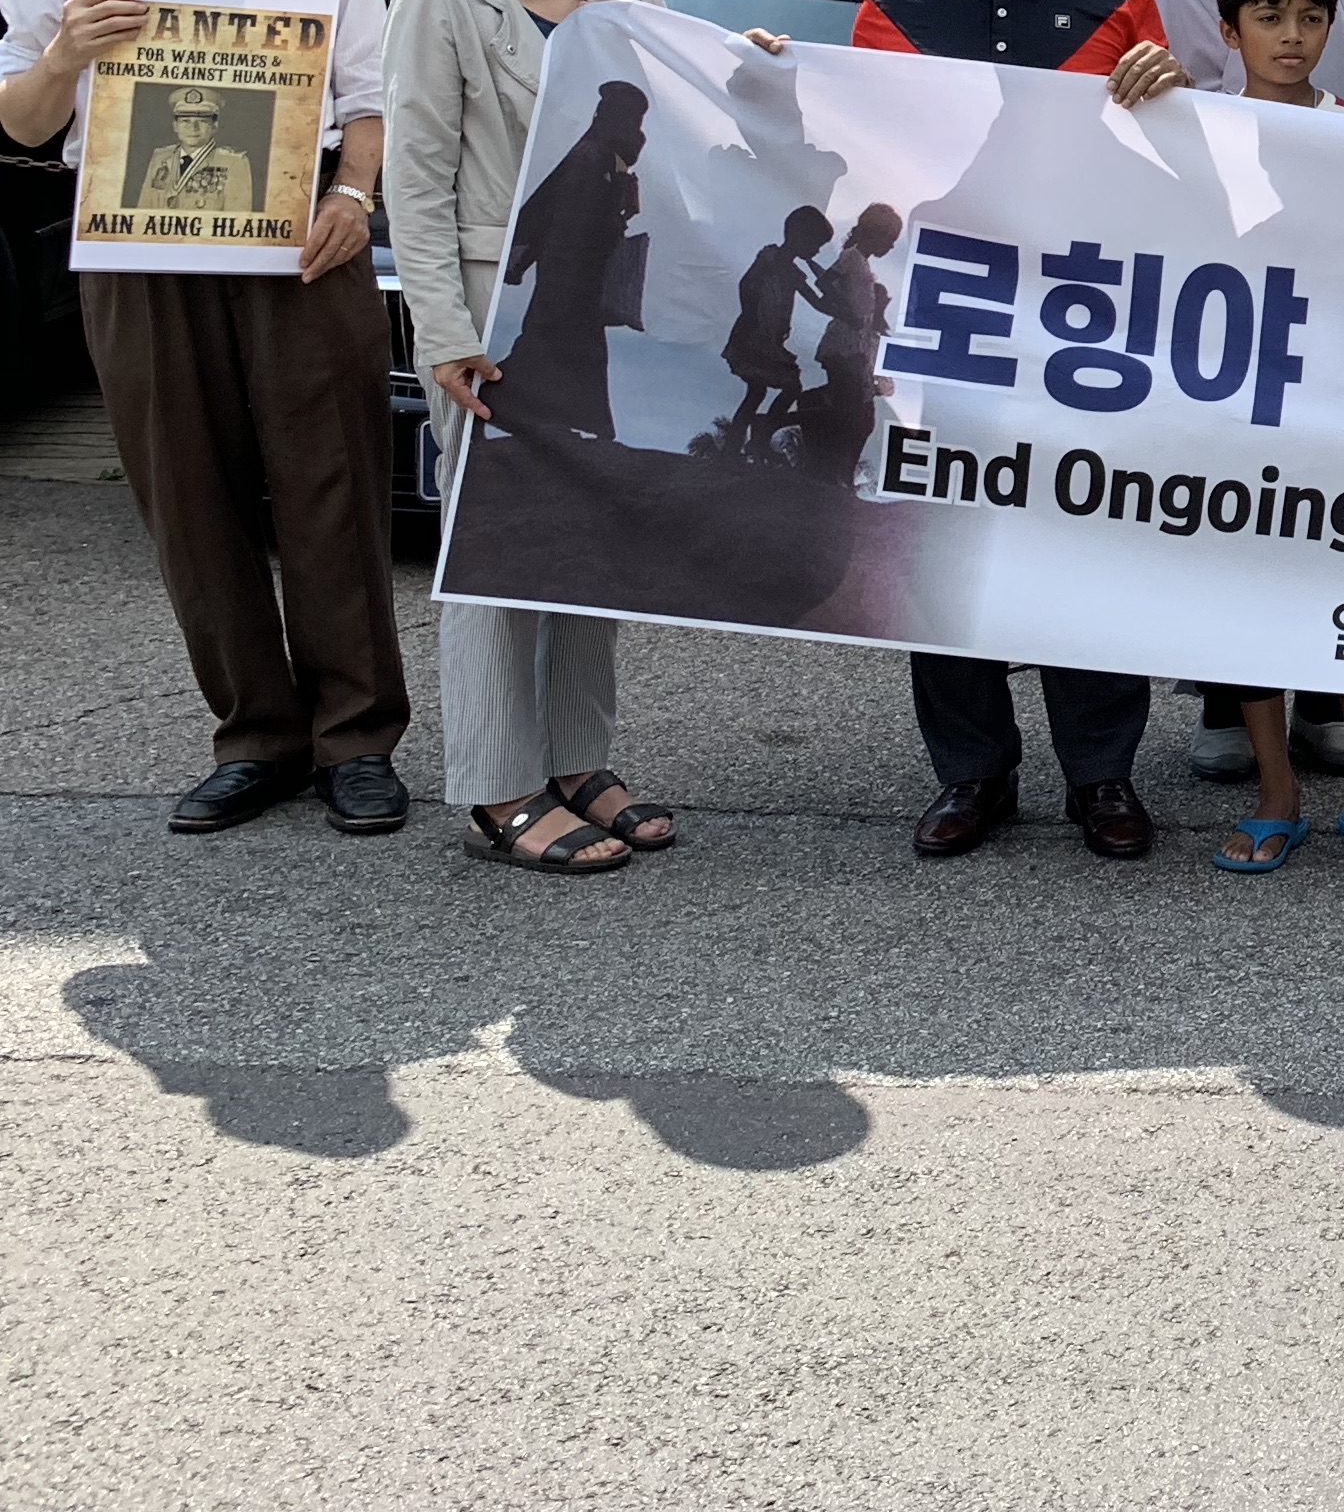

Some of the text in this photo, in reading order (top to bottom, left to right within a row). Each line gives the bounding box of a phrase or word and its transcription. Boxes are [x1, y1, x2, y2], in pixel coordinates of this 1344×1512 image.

[151, 8, 326, 51] ANTED
[97, 61, 315, 88] CRIMES AGAINST HUMANITY
[136, 47, 282, 68] FOR WAR CRIMES &
[86, 214, 293, 239] MIN AUNG HLAING
[882, 226, 1309, 428] 로힝야
[882, 424, 1032, 508] End
